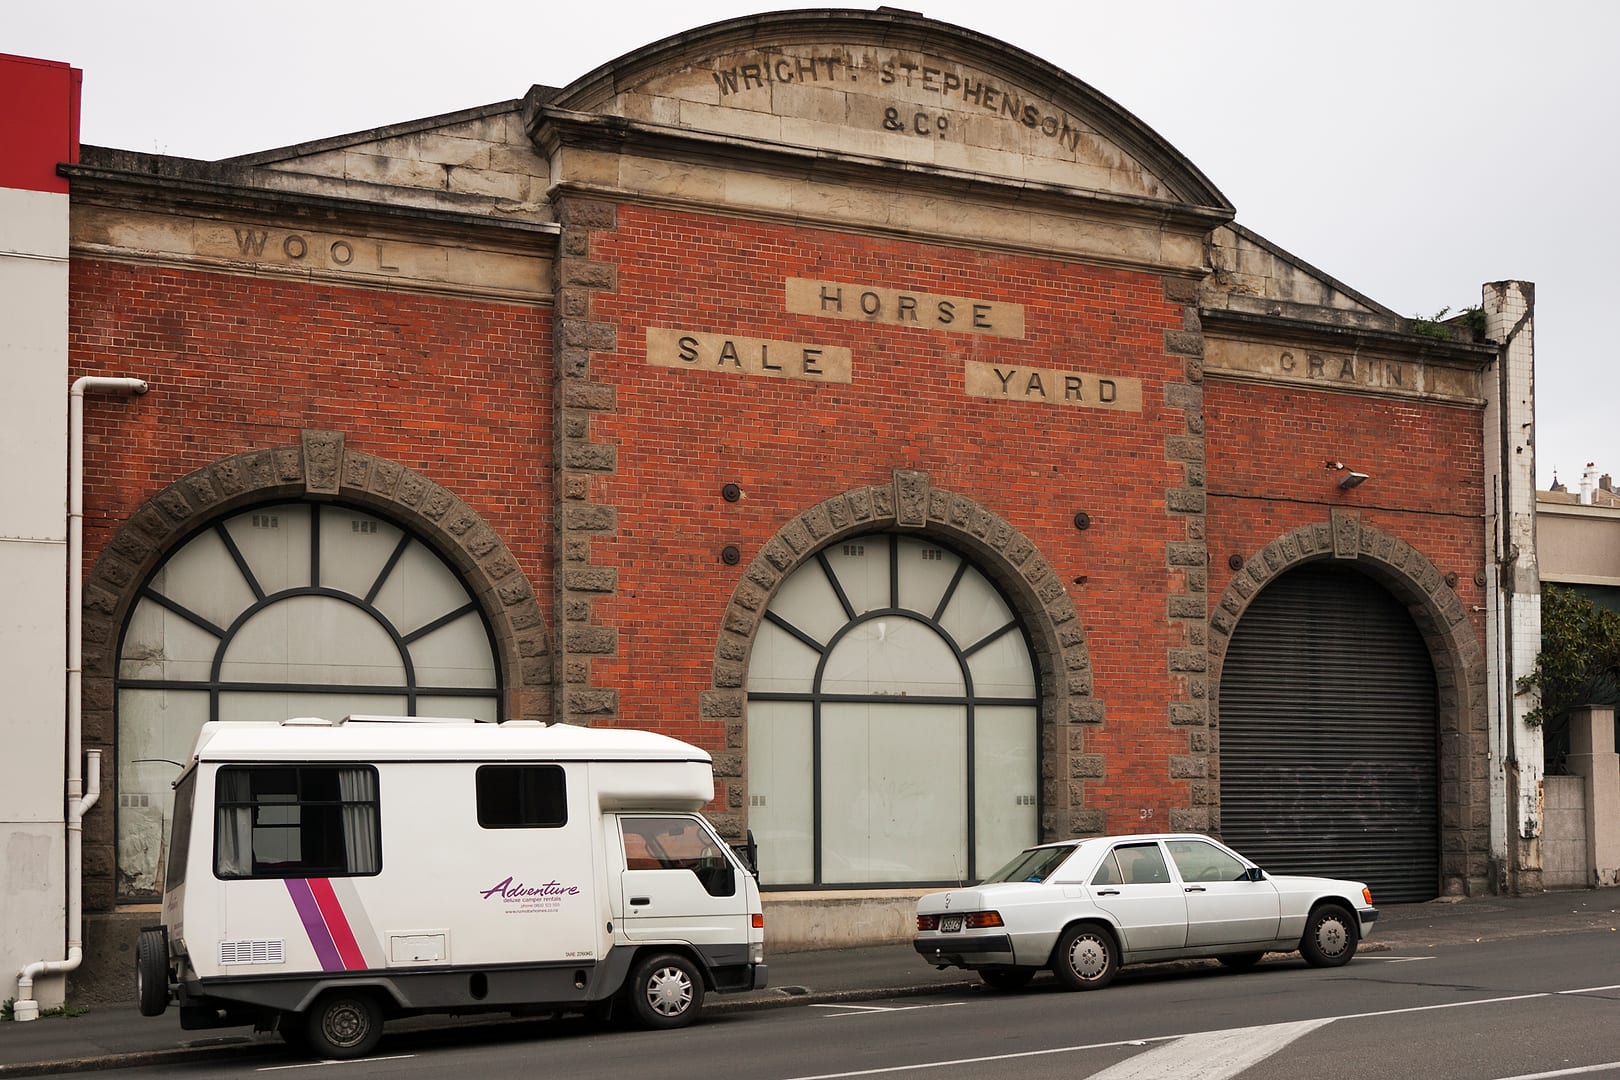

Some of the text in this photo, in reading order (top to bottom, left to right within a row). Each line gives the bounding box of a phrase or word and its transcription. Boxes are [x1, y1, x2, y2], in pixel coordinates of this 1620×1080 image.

[880, 62, 1081, 152] STEPHENSON
[882, 107, 905, 131] &
[234, 228, 399, 272] WOOL
[819, 285, 993, 329] HORSE
[677, 335, 824, 376] SALE
[1280, 351, 1402, 386] GRAIN
[993, 367, 1118, 404] YARD
[480, 876, 580, 899] Adventure
